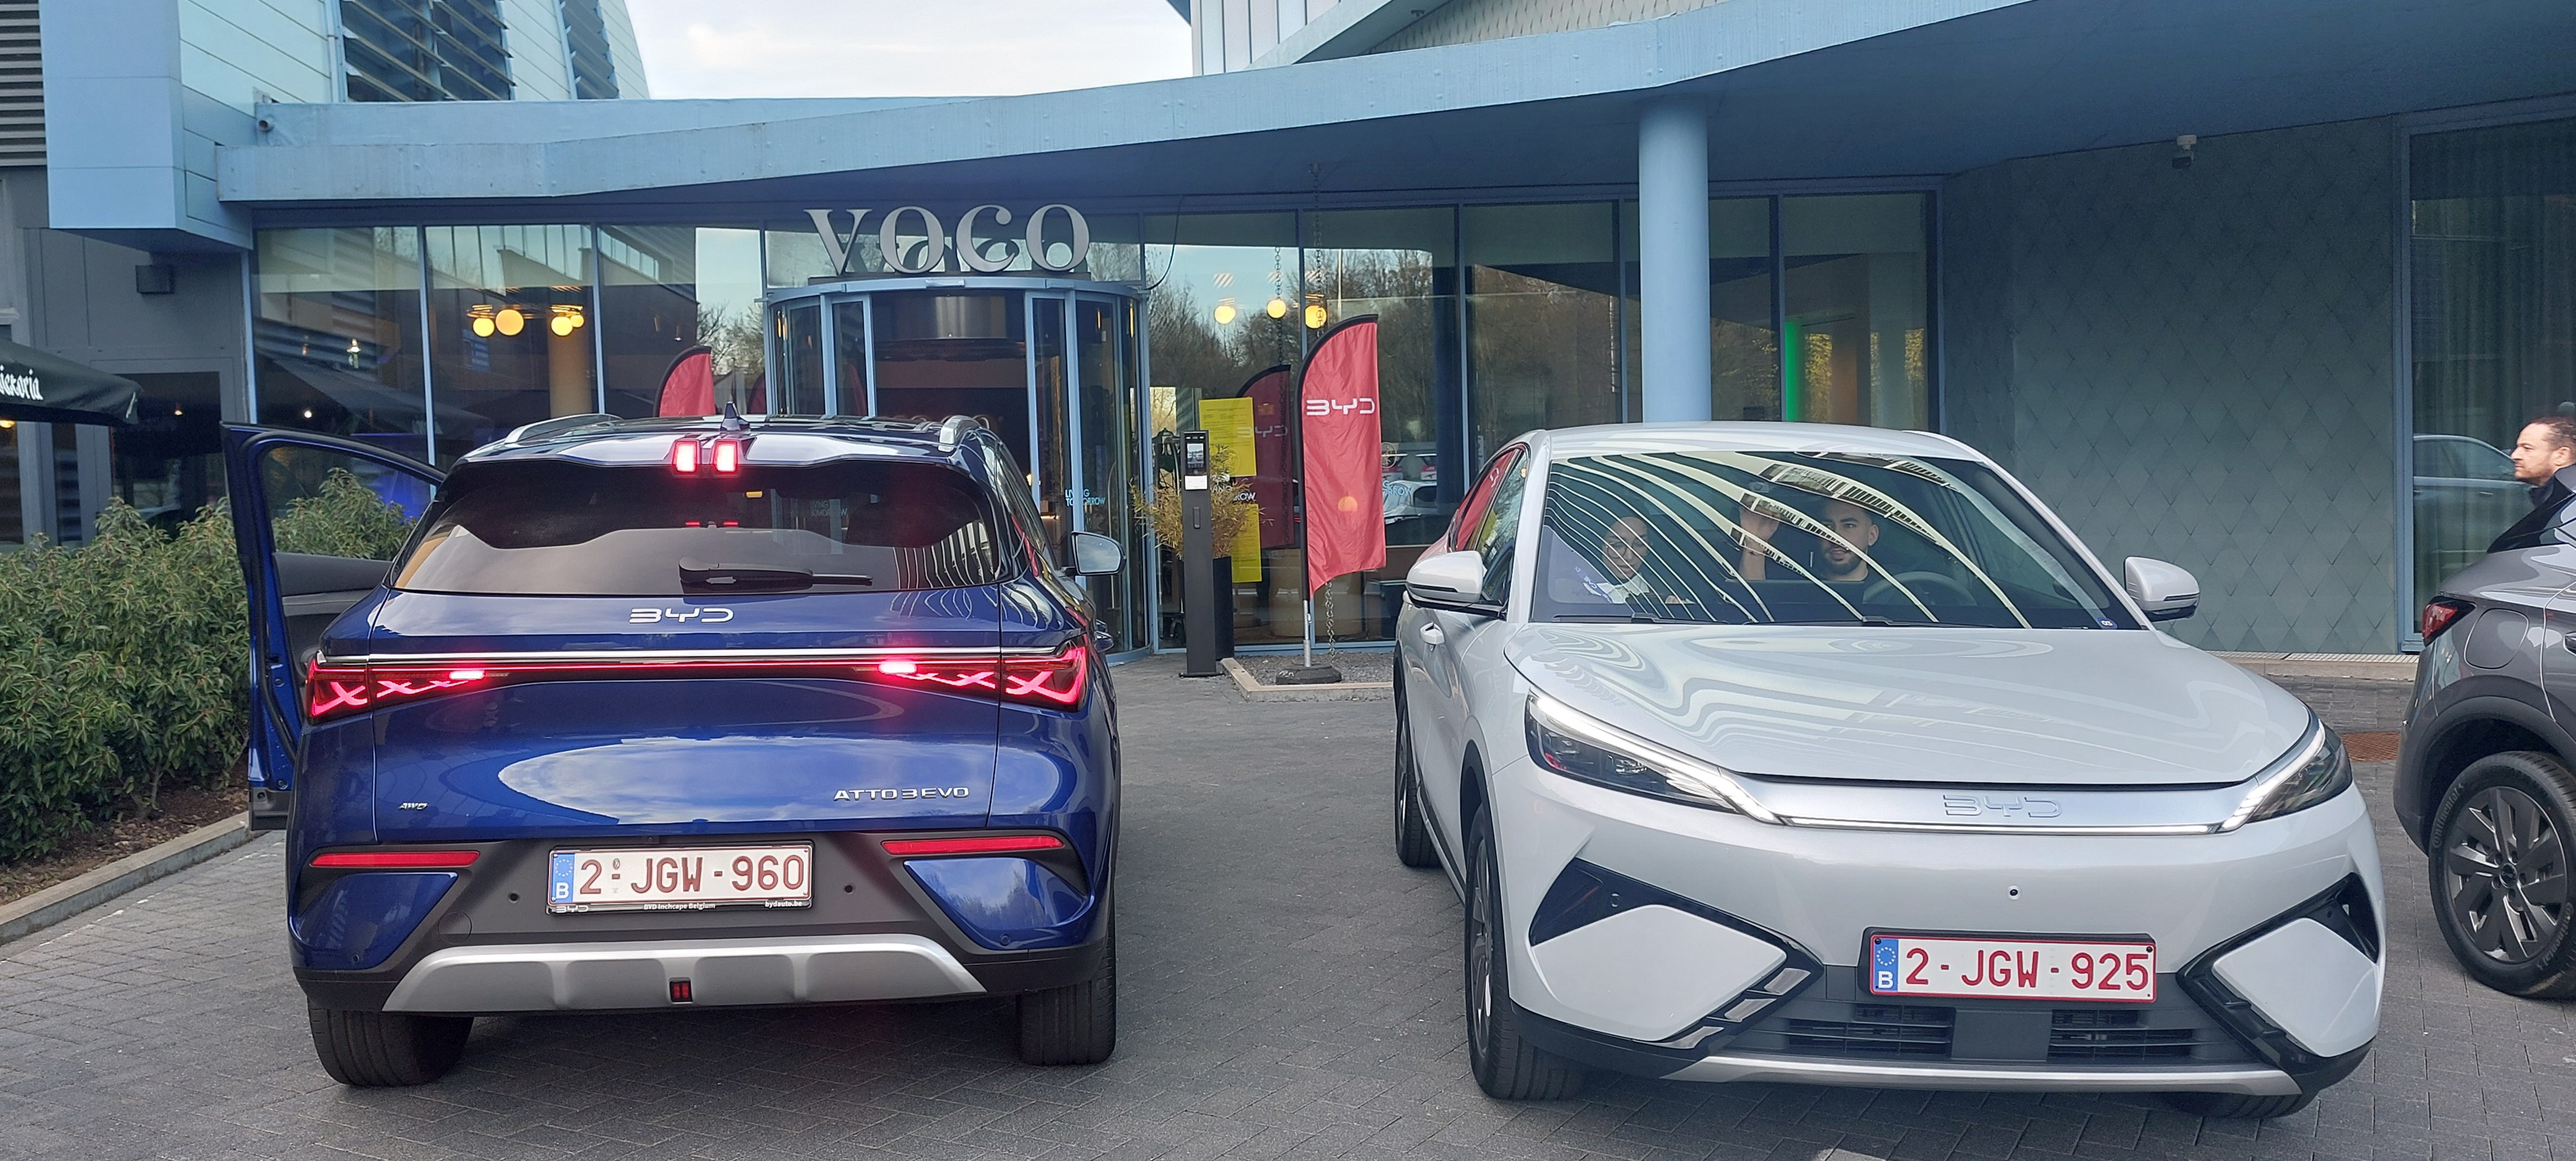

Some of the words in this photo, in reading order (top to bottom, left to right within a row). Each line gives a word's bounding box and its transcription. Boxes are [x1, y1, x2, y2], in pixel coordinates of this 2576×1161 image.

[1306, 398, 1375, 415] BYD
[1237, 425, 1288, 438] BYD
[629, 608, 734, 623] BYD
[833, 789, 897, 801] ATTO
[901, 789, 918, 799] 3
[921, 787, 969, 799] EVO
[1943, 794, 2062, 818] BYD
[579, 855, 804, 895] 2-JGW-960
[555, 882, 570, 899] B
[556, 905, 589, 913] BYD
[688, 902, 716, 910] Belgium
[1906, 947, 2149, 991] 2-JGW-925
[1878, 970, 1894, 989] B
